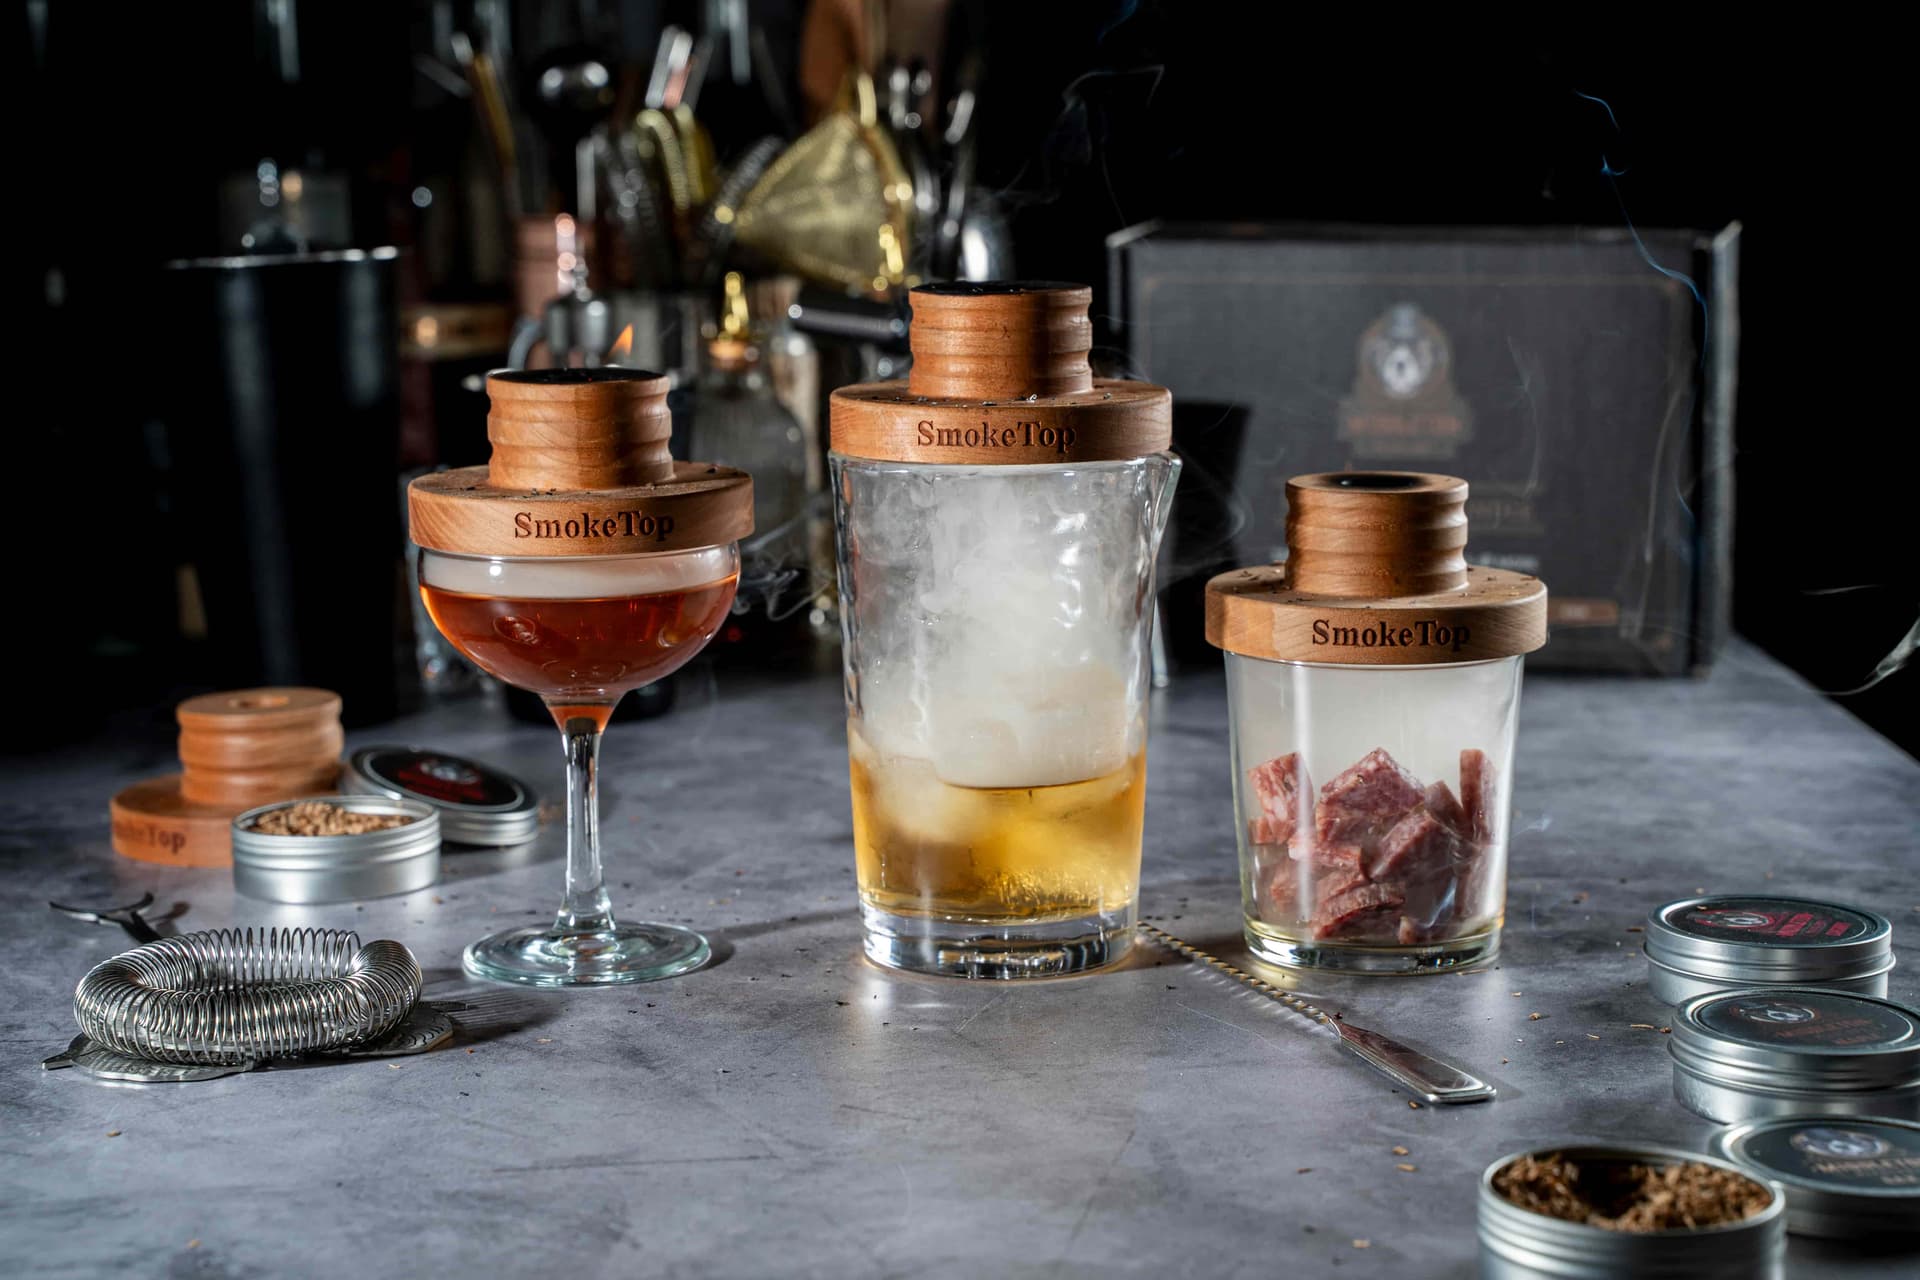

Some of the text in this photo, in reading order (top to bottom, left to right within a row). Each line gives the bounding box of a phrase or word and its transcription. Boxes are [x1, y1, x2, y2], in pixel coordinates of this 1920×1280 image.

[917, 419, 1077, 454] SmokeTop
[514, 510, 675, 542] SmokeTop
[1312, 619, 1471, 652] SmokeTop
